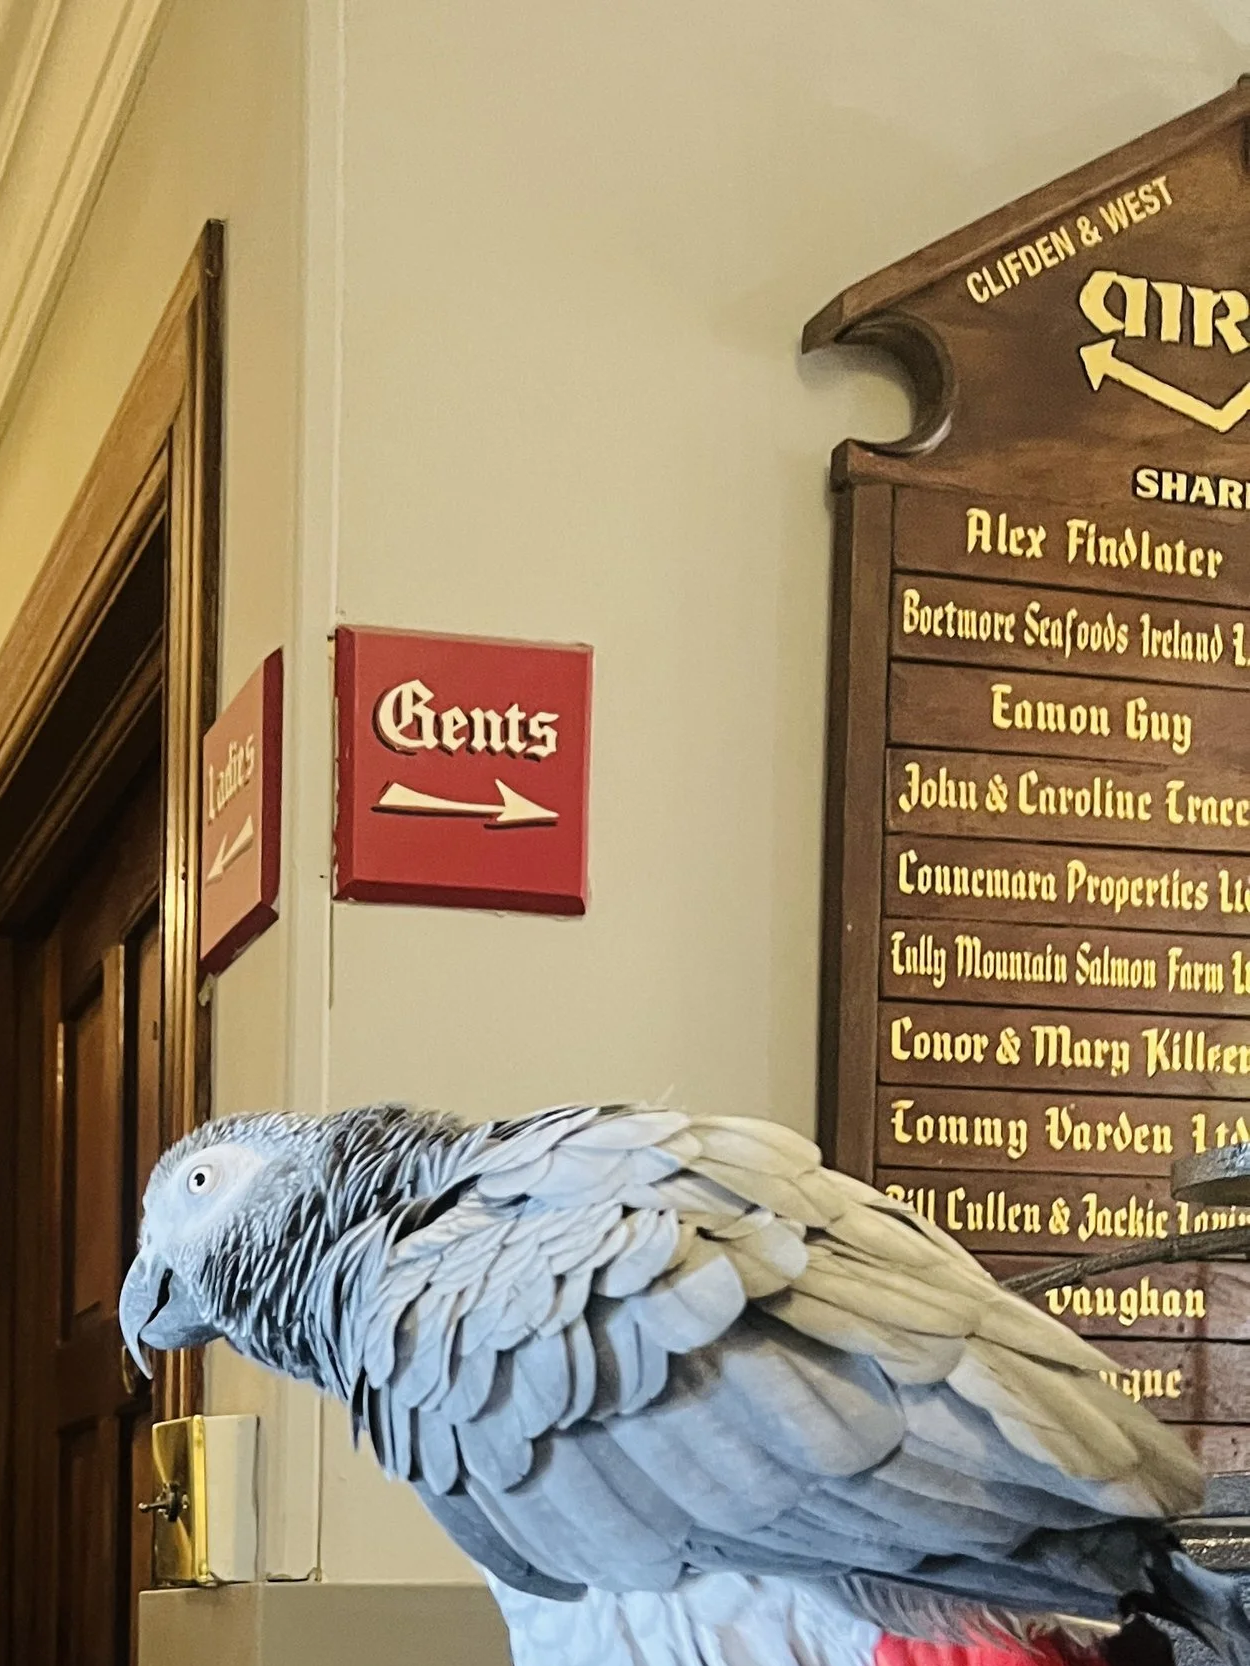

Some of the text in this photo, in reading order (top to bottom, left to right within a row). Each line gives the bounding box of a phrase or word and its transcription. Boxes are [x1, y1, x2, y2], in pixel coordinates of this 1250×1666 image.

[966, 175, 1174, 304] CLIFDEN & WEST
[1136, 468, 1250, 510] SHAR
[966, 507, 1223, 579] Alex Findlater
[1024, 600, 1129, 658] Seafoods
[1140, 612, 1223, 664] Ireland
[377, 678, 560, 758] Gents
[991, 683, 1192, 754] Eamon Guy
[898, 762, 977, 813] John
[984, 774, 1008, 813] &
[1018, 770, 1152, 821] Caroline
[898, 849, 1057, 904] Connemara
[1066, 859, 1208, 914] Properties
[891, 931, 947, 989] Tully
[954, 935, 1068, 984] Mountain
[1076, 941, 1157, 990] Salmon
[1168, 947, 1224, 993] Farm
[891, 1015, 989, 1064] Conor
[995, 1026, 1022, 1066] &
[1031, 1025, 1130, 1077] Mary
[891, 1100, 1028, 1160] Tommy
[1045, 1106, 1173, 1154] Varden
[947, 1187, 1041, 1234] Cullen
[1049, 1197, 1070, 1235] &
[1078, 1192, 1168, 1242] Jackie
